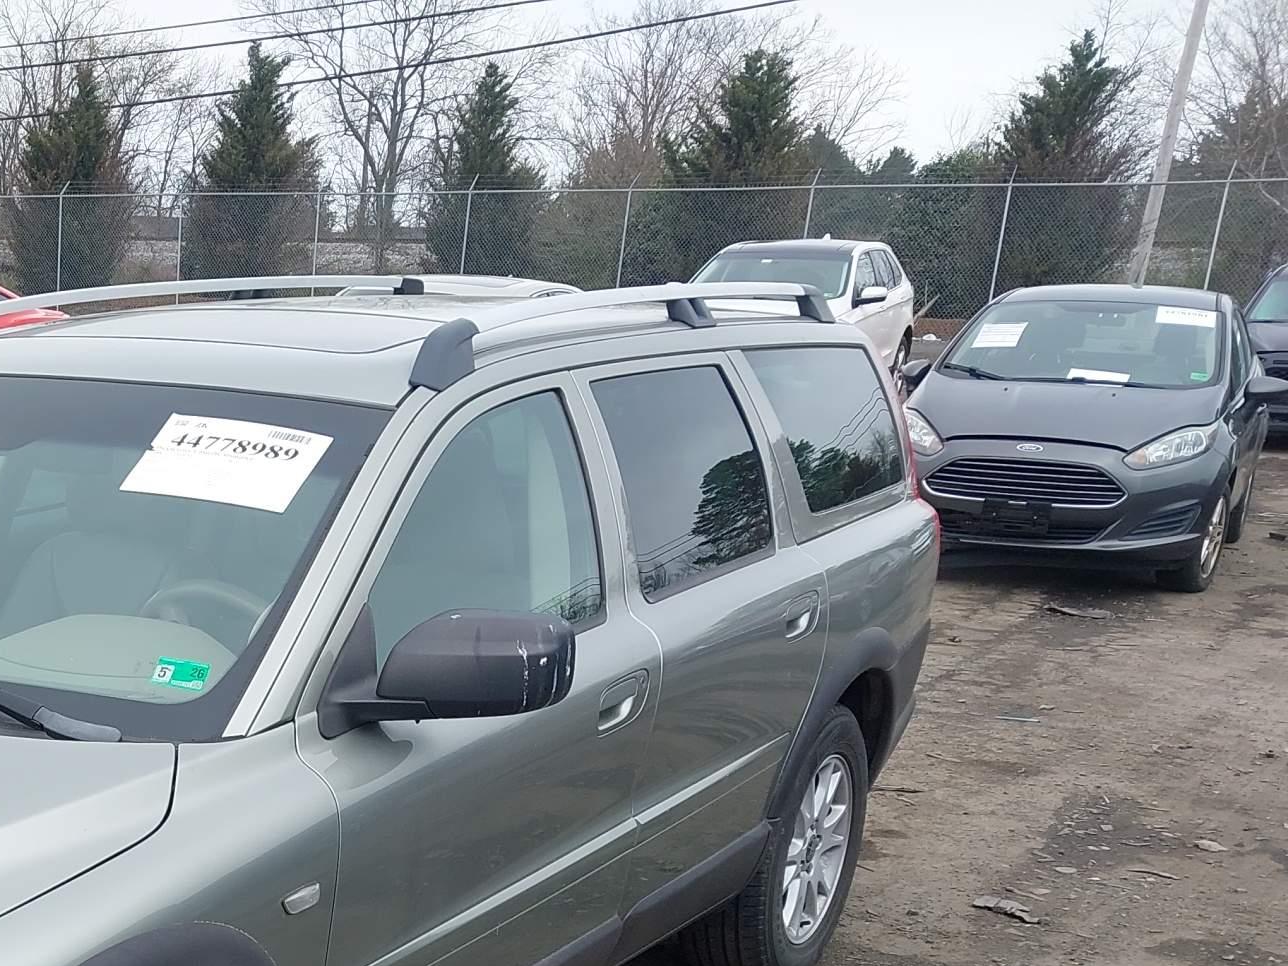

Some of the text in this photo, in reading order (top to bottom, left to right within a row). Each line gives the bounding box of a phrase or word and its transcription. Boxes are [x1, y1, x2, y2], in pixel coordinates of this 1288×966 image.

[170, 432, 300, 462] 44778989
[158, 666, 205, 679] 5 26
